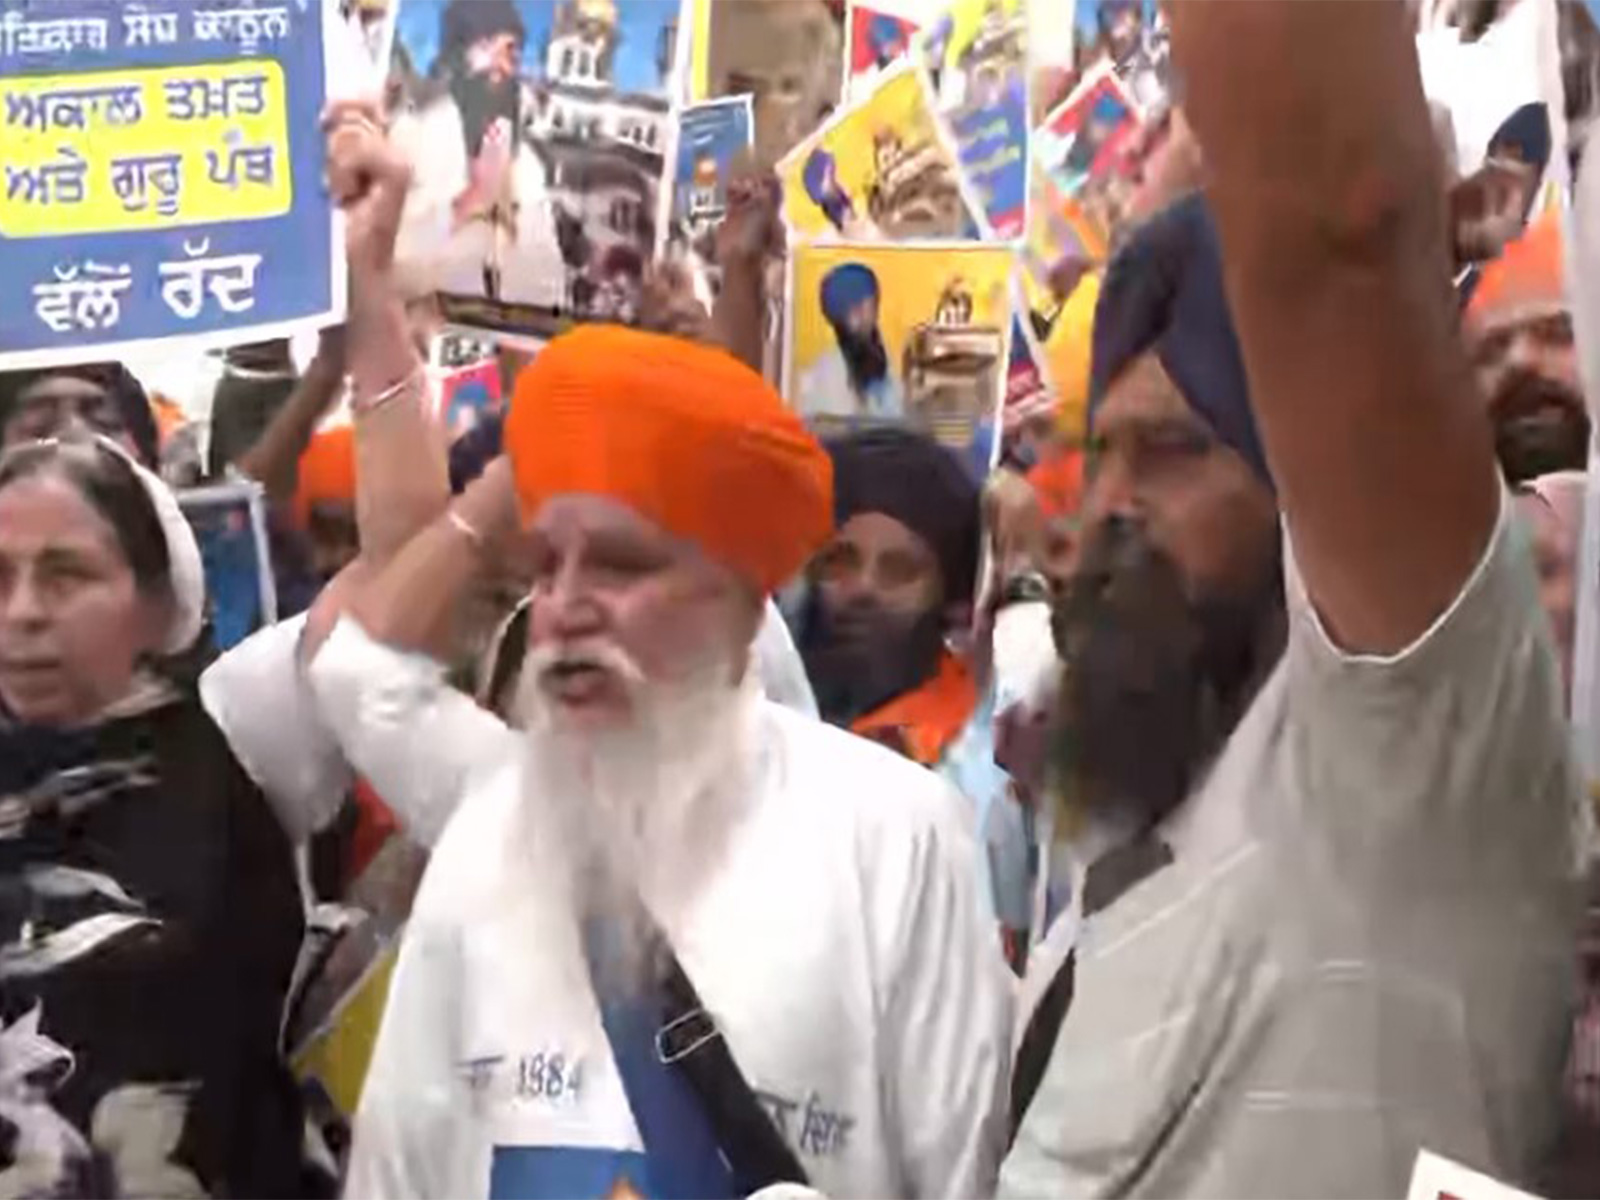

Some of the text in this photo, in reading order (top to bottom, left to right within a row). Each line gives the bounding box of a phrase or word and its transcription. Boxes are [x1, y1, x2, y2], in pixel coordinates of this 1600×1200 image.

[0, 10, 107, 55] ਤਿਕਾਰ
[6, 86, 142, 132] ਅਕਾਲ
[5, 130, 274, 216] ਅਤੇ ਗੁਰੂ ਪੰਥ
[32, 237, 263, 331] ਵੱਲੋਂ ਰੱਦ
[516, 1053, 584, 1100] 1984
